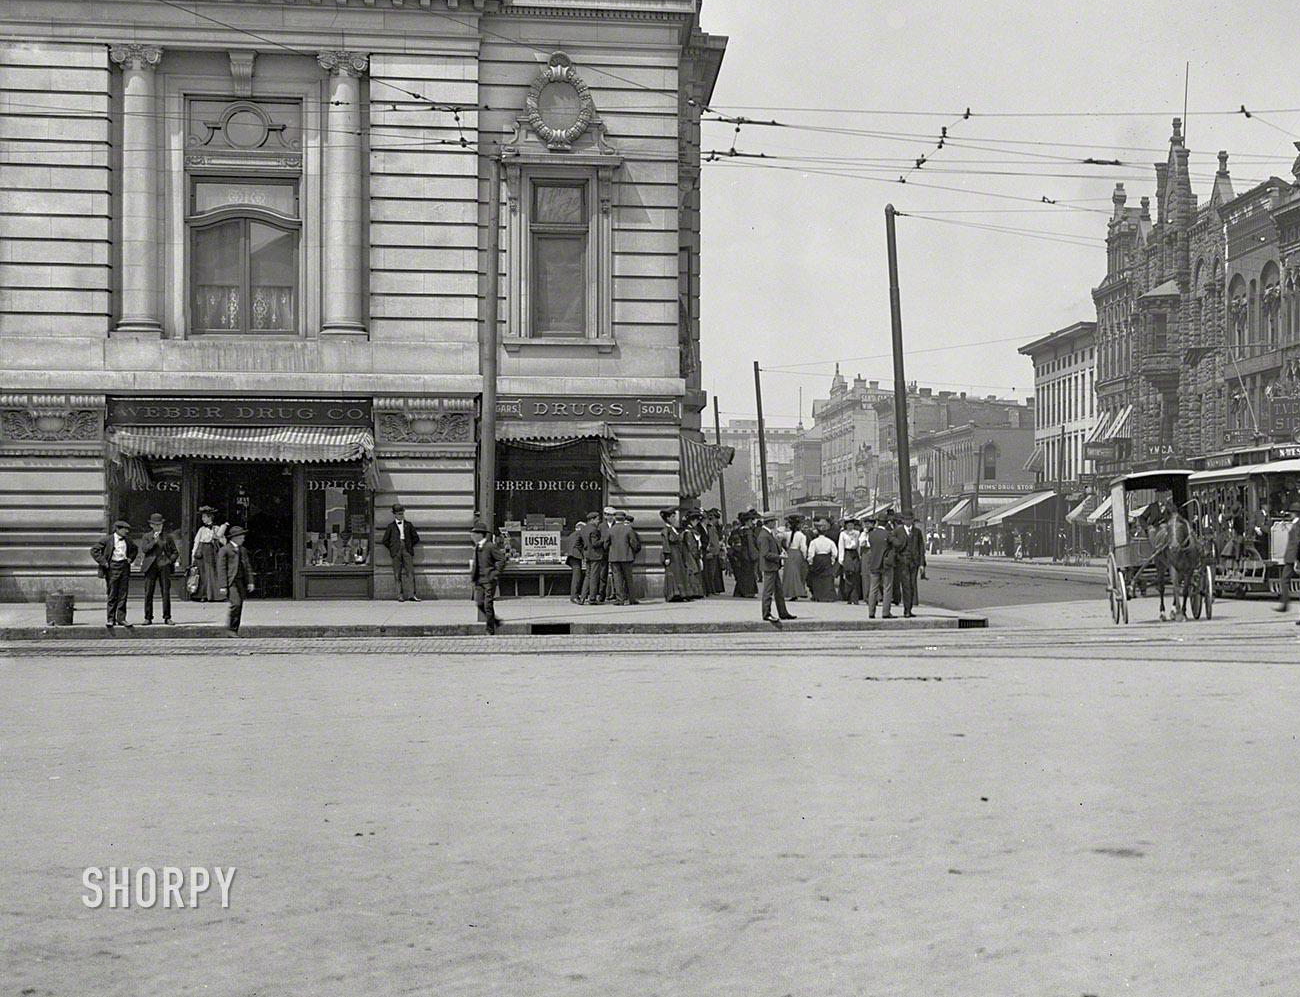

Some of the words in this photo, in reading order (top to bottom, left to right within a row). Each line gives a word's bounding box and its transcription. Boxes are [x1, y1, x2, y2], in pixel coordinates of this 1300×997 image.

[117, 406, 223, 419] WEBER
[236, 407, 314, 420] DRUG
[327, 407, 369, 420] CO.
[496, 405, 518, 414] GARS.
[533, 402, 629, 416] DRUGS.
[641, 405, 673, 415] SODA.
[308, 479, 368, 492] DRUGS
[495, 481, 533, 491] EBER
[537, 481, 575, 491] DRUG
[525, 536, 557, 546] LUSTRAL
